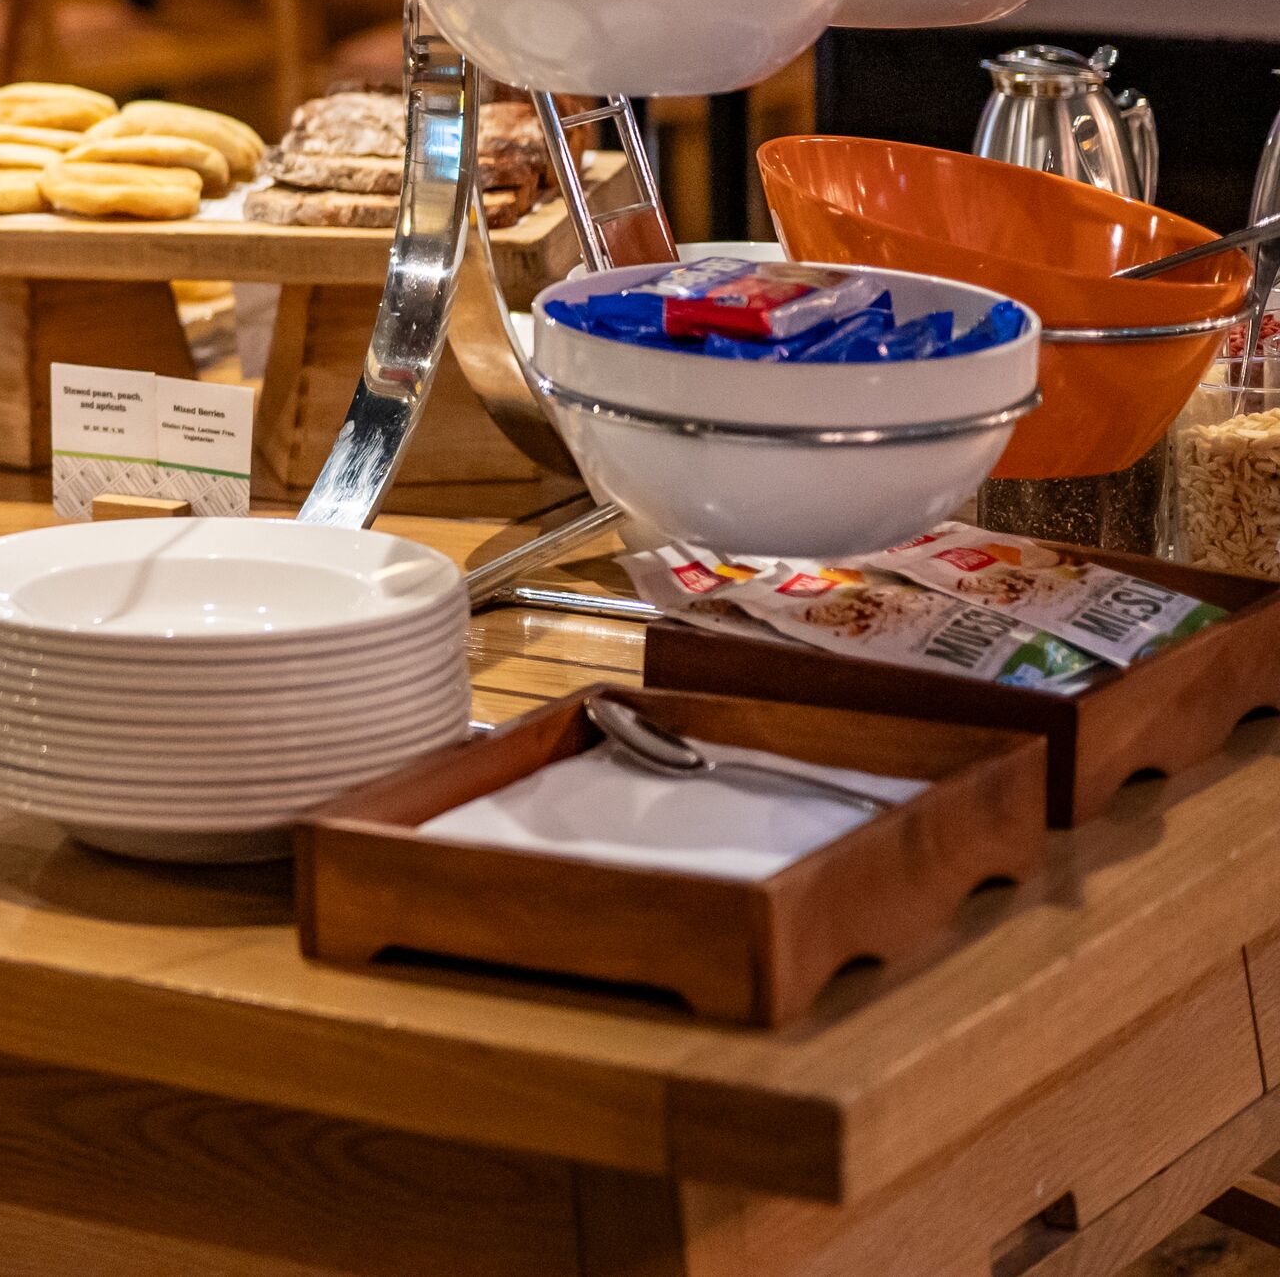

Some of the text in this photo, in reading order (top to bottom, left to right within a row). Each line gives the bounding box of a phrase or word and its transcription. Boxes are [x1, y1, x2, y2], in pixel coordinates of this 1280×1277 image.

[63, 386, 143, 402] Stewed pears, peach,
[80, 401, 127, 412] and apricots
[173, 404, 225, 418] Mixed Berries
[184, 434, 215, 443] Vegetarian
[1071, 578, 1179, 643] MUESLI
[924, 609, 1021, 668] MUESL
